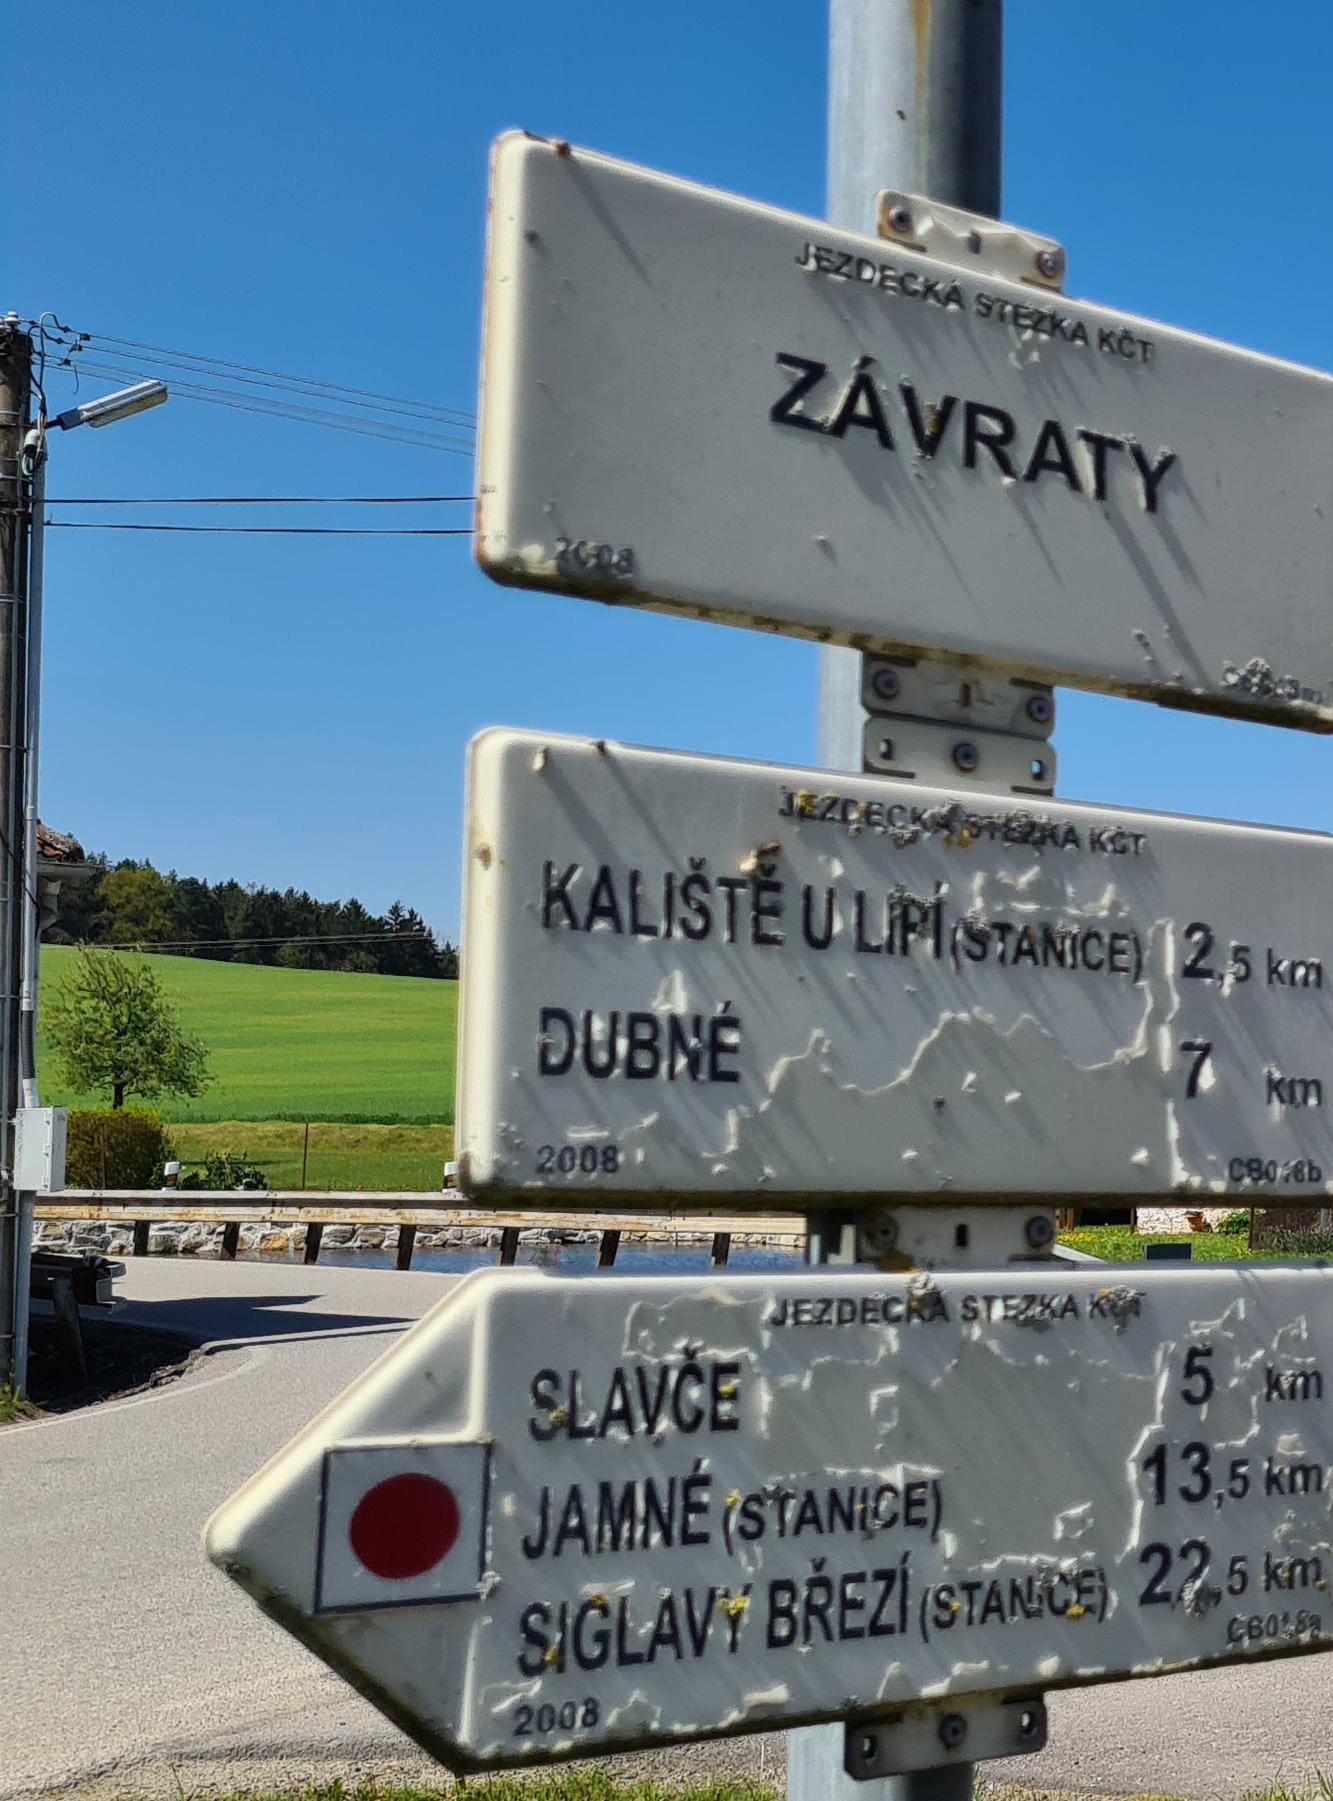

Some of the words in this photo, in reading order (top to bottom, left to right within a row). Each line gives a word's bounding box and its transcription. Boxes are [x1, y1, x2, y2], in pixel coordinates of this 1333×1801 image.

[796, 242, 966, 311] JEZDECKÁ
[974, 292, 1090, 347] STEZKA
[1098, 325, 1155, 363] KČT
[770, 351, 1178, 514] ZÁVRATY
[541, 851, 786, 946] KALIŠTĚ
[803, 883, 838, 950] U
[855, 880, 945, 960] LIPÍ
[1266, 947, 1323, 989] km
[538, 1000, 740, 1082] DUBNÉ
[1181, 1040, 1213, 1099] 7
[1266, 1072, 1323, 1108] km
[535, 1144, 620, 1173] 2008
[959, 1292, 1080, 1323] STEZKA
[529, 1346, 741, 1442] SLAVČE
[1181, 1346, 1213, 1406] 5
[1265, 1364, 1323, 1402] km
[522, 1457, 713, 1560] JAMNÉ
[721, 1478, 943, 1557] (STANICE)
[1142, 1441, 1249, 1508] 13,5
[1265, 1457, 1323, 1497] km
[766, 1551, 911, 1649] BŘEZÍ
[1264, 1551, 1323, 1594] km
[513, 1696, 599, 1737] 2008
